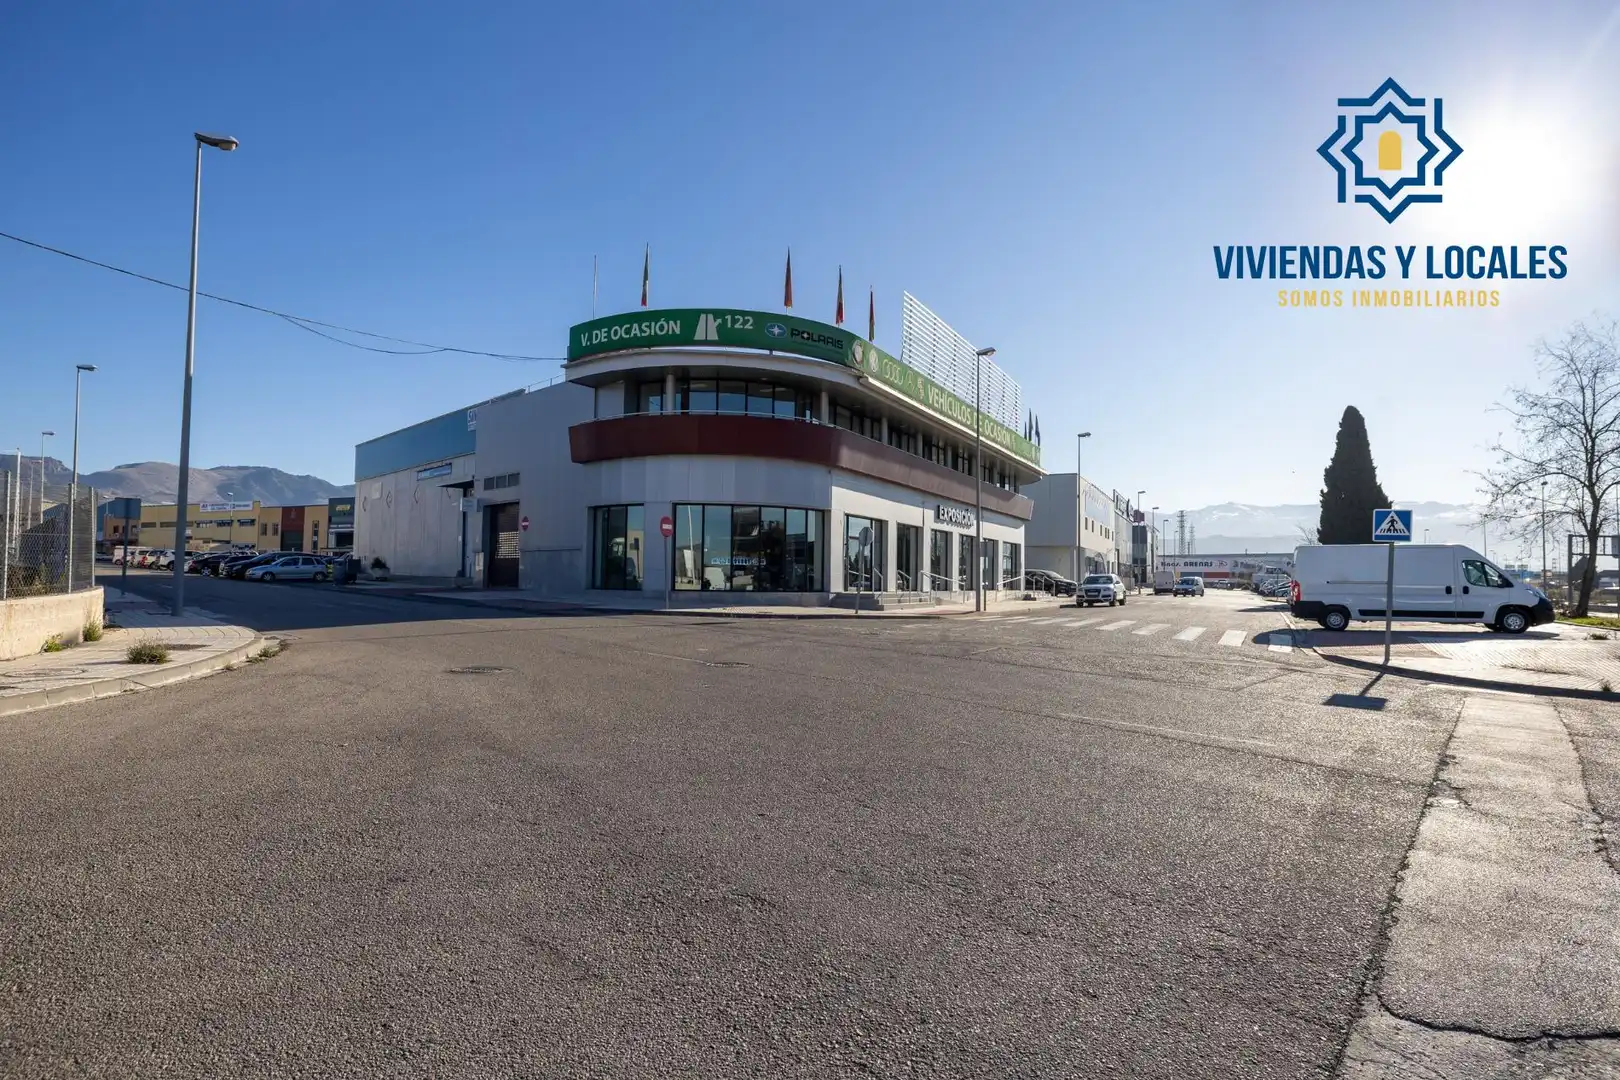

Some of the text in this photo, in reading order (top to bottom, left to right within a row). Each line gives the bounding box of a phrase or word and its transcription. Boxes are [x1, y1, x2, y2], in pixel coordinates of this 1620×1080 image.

[581, 317, 681, 347] V. DE OCASIÓN
[724, 314, 754, 329] 122
[790, 327, 844, 350] POLARIS
[928, 384, 971, 425] VEHÍCULOS
[984, 419, 1011, 447] OCASIÓN
[938, 504, 975, 525] EXPOSICIÓN
